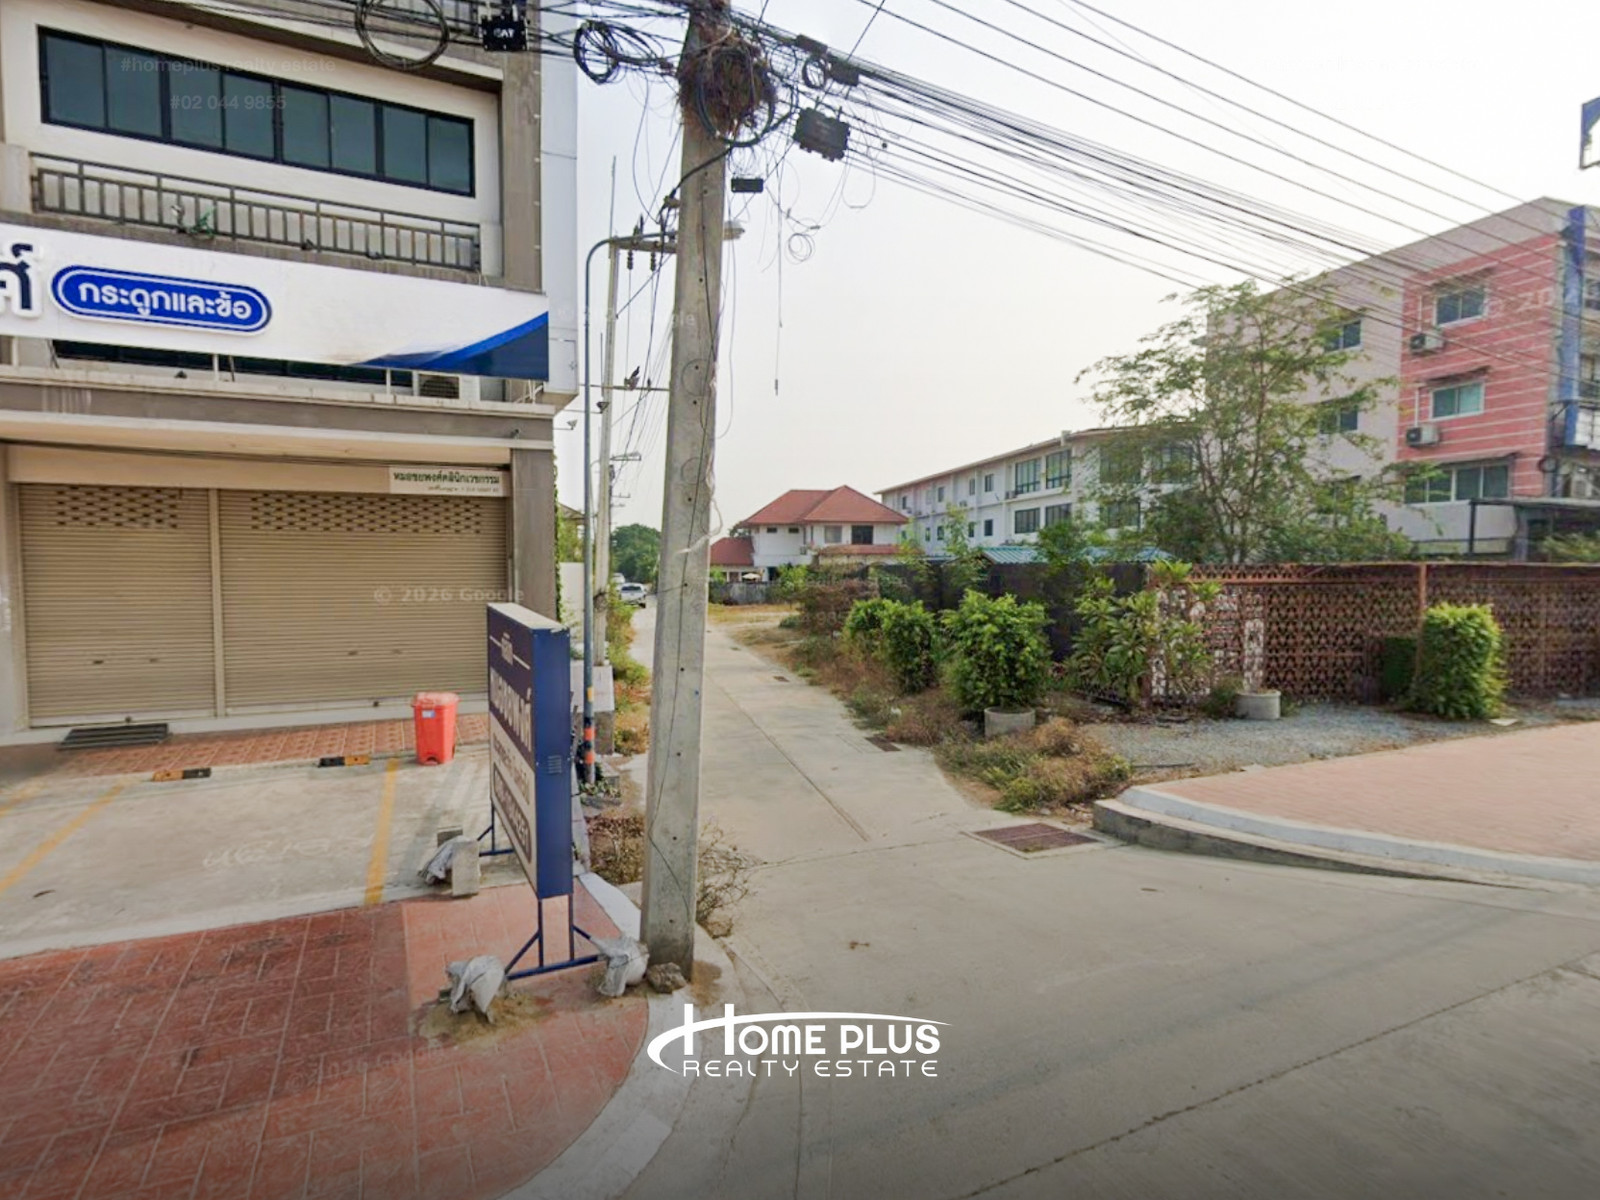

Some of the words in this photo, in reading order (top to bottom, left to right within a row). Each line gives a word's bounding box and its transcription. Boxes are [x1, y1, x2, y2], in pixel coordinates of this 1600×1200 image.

[78, 282, 252, 320] กระดูกและข้อ
